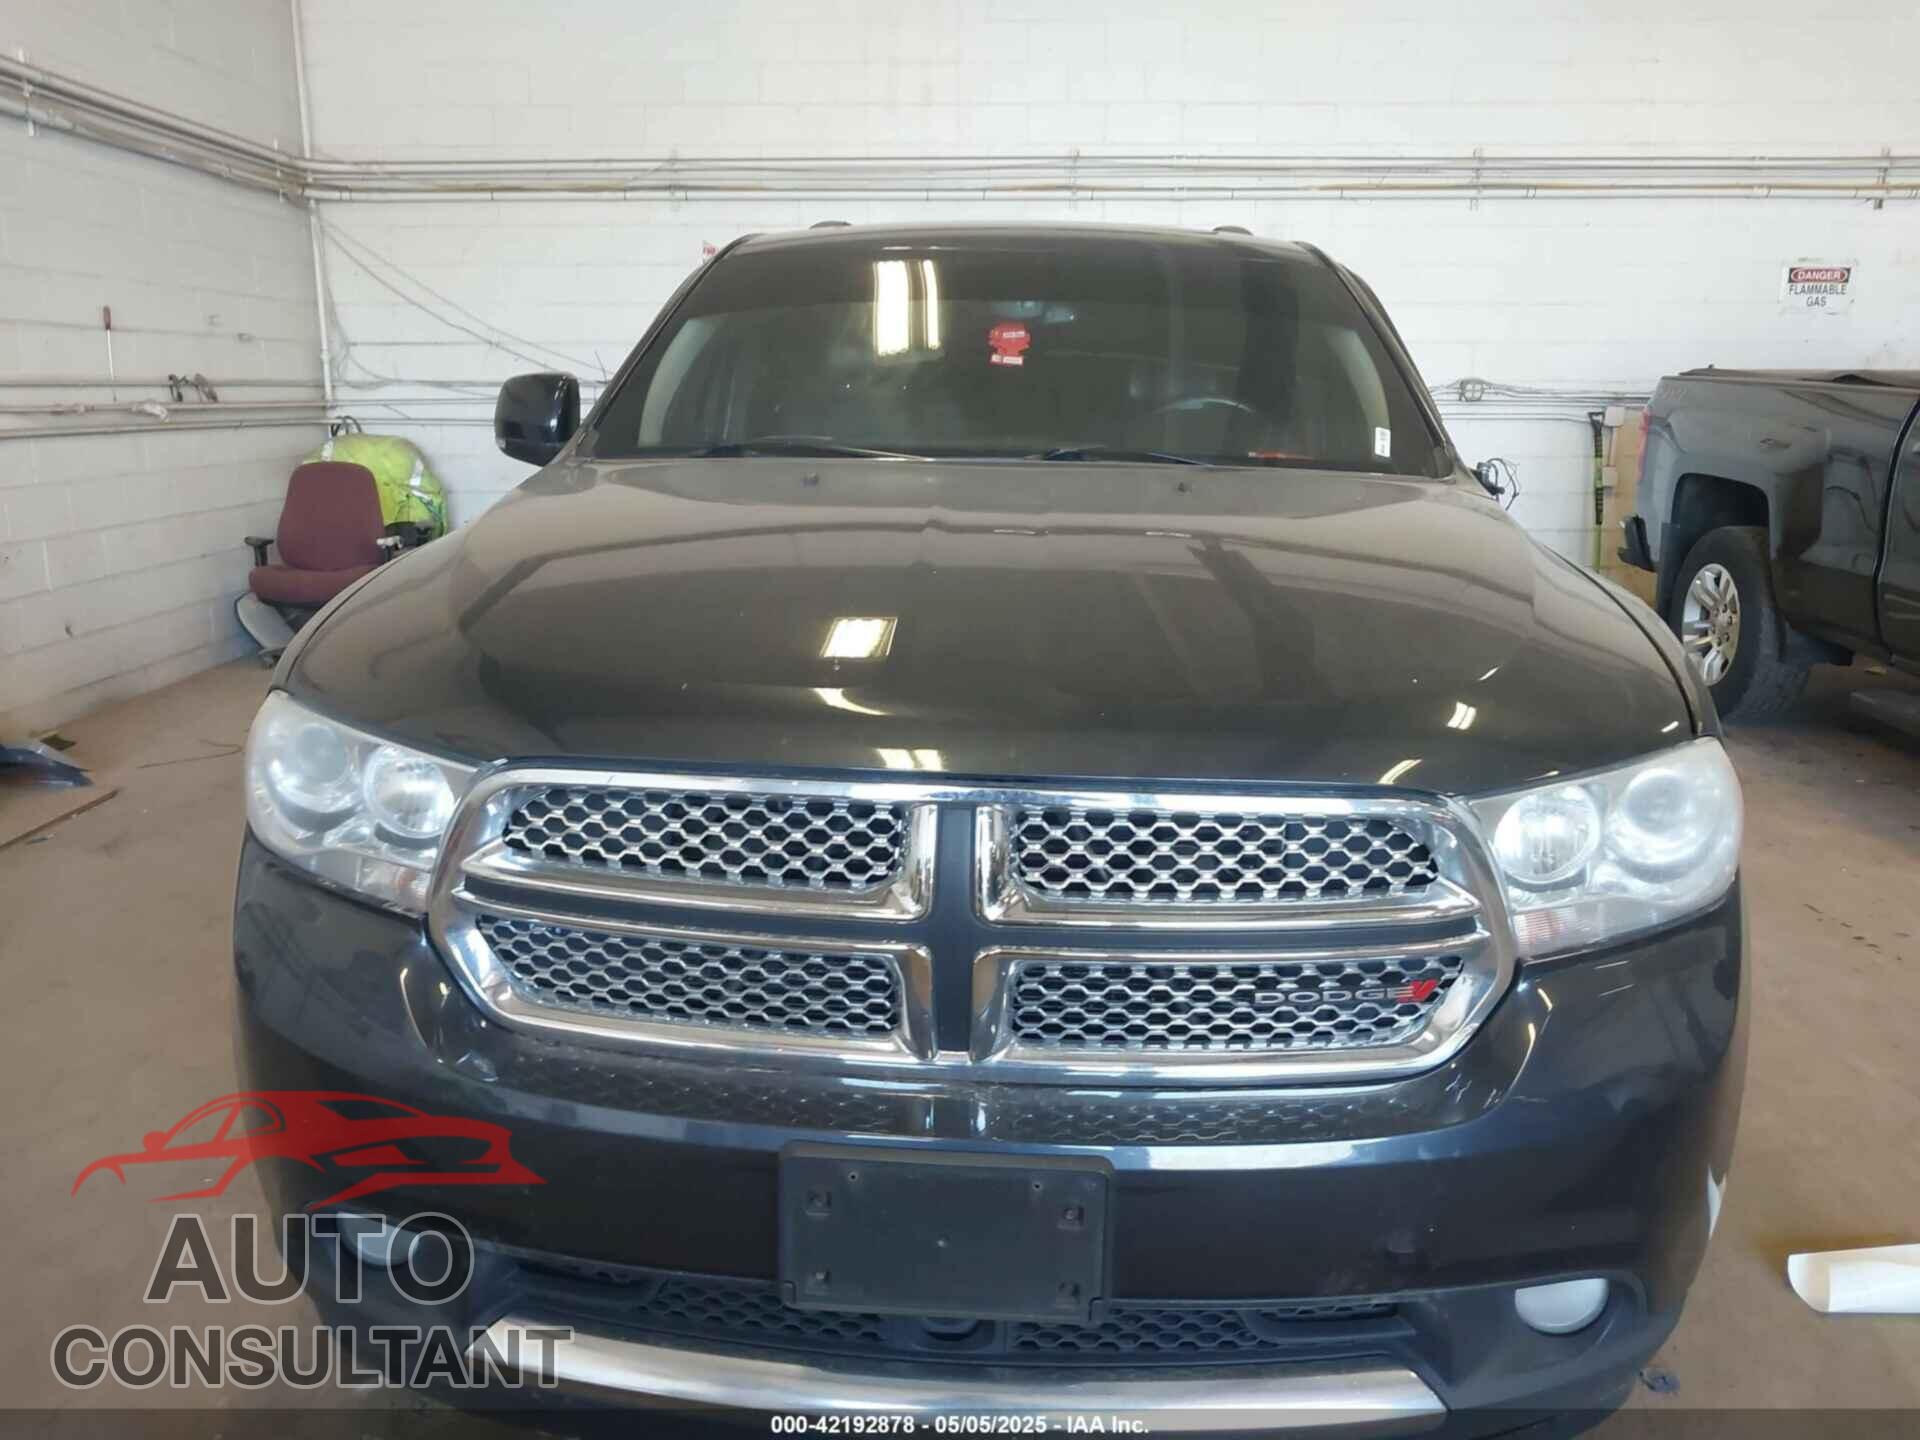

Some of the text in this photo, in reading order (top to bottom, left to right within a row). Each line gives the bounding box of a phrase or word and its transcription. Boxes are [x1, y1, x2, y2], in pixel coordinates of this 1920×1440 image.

[1798, 271, 1840, 280] DANGER
[1789, 284, 1847, 295] FLAMMABLE
[1806, 296, 1827, 307] GAS
[1255, 986, 1414, 1004] DODGE
